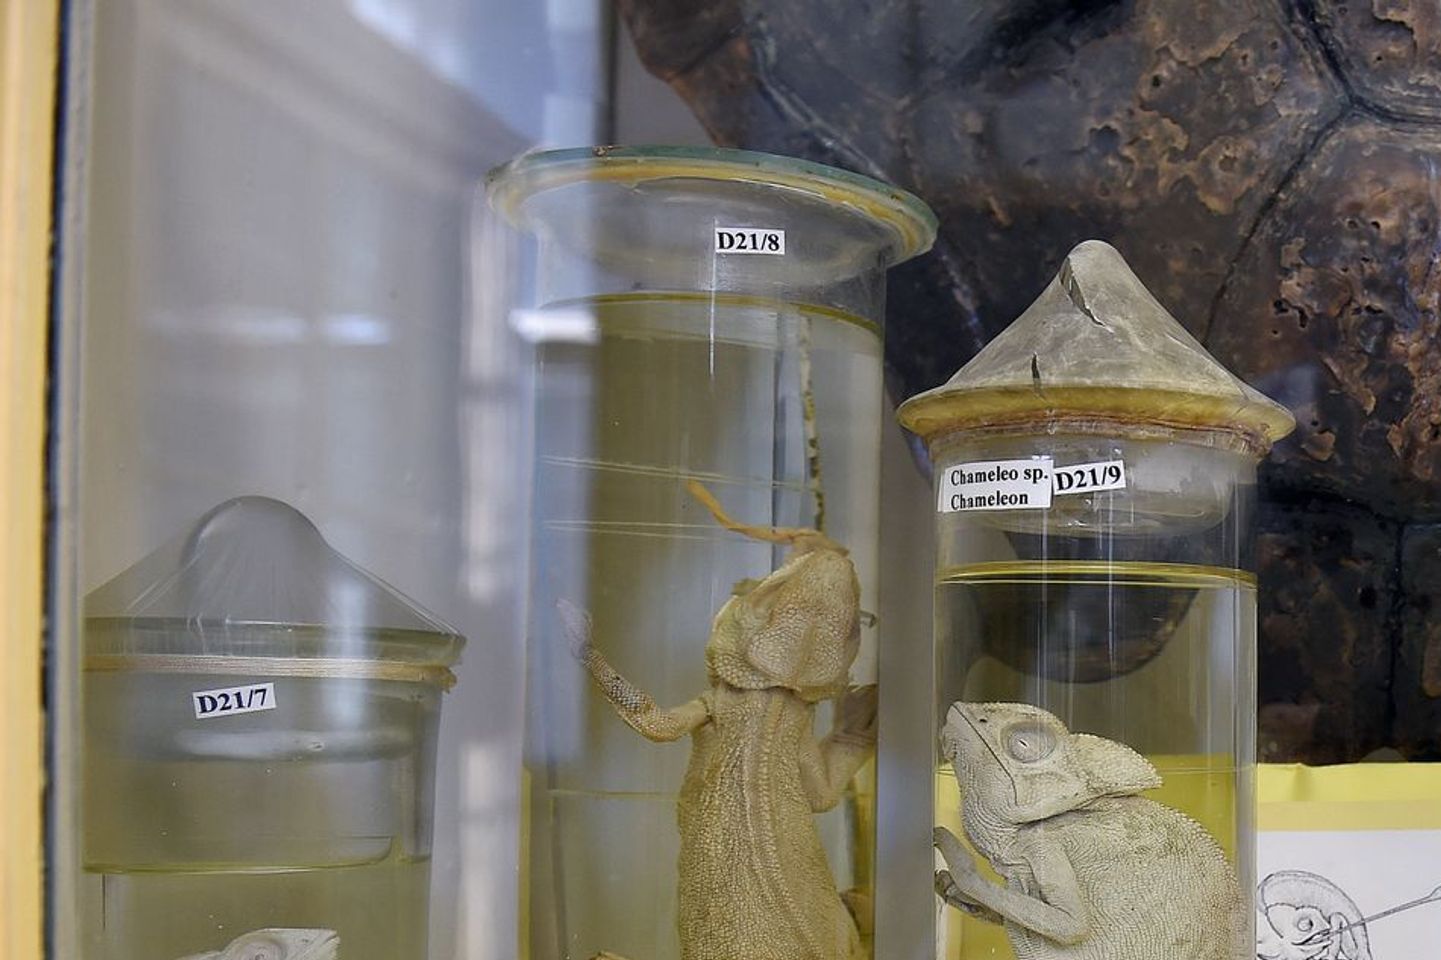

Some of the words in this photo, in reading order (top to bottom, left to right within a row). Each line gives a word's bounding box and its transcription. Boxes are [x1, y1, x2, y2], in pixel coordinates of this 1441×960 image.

[717, 231, 780, 251] D21/8
[950, 465, 1018, 486] Chameleo
[1023, 467, 1049, 484] sp.
[1054, 464, 1122, 491] D21/9
[950, 490, 1029, 510] Chameleon
[196, 688, 267, 714] D21/7
